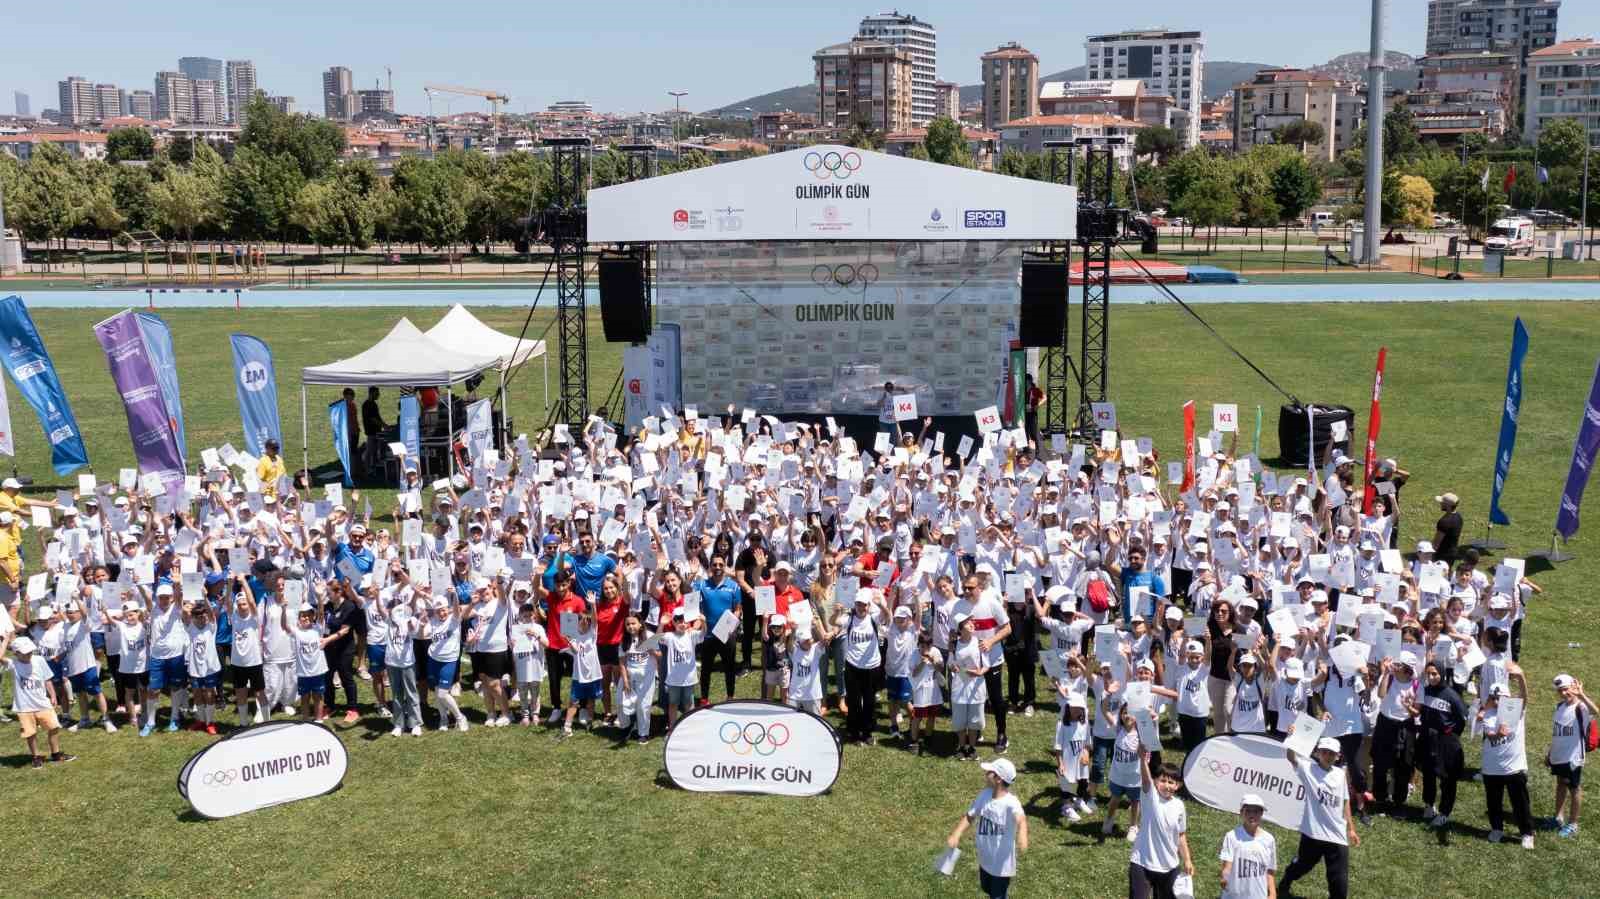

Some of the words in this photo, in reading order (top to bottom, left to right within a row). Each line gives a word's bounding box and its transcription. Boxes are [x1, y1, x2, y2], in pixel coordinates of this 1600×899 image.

[796, 183, 842, 200] OLİMPİK
[846, 184, 870, 200] GÜN
[966, 210, 1003, 220] SPOR
[899, 403, 912, 412] K4
[982, 415, 996, 425] K3
[1219, 413, 1232, 422] K1
[242, 755, 302, 782] OLYMPIC
[307, 749, 331, 769] DAY
[692, 762, 766, 781] OLİMPİK
[771, 766, 812, 784] GÜN
[1233, 766, 1293, 797] OLYMPIC
